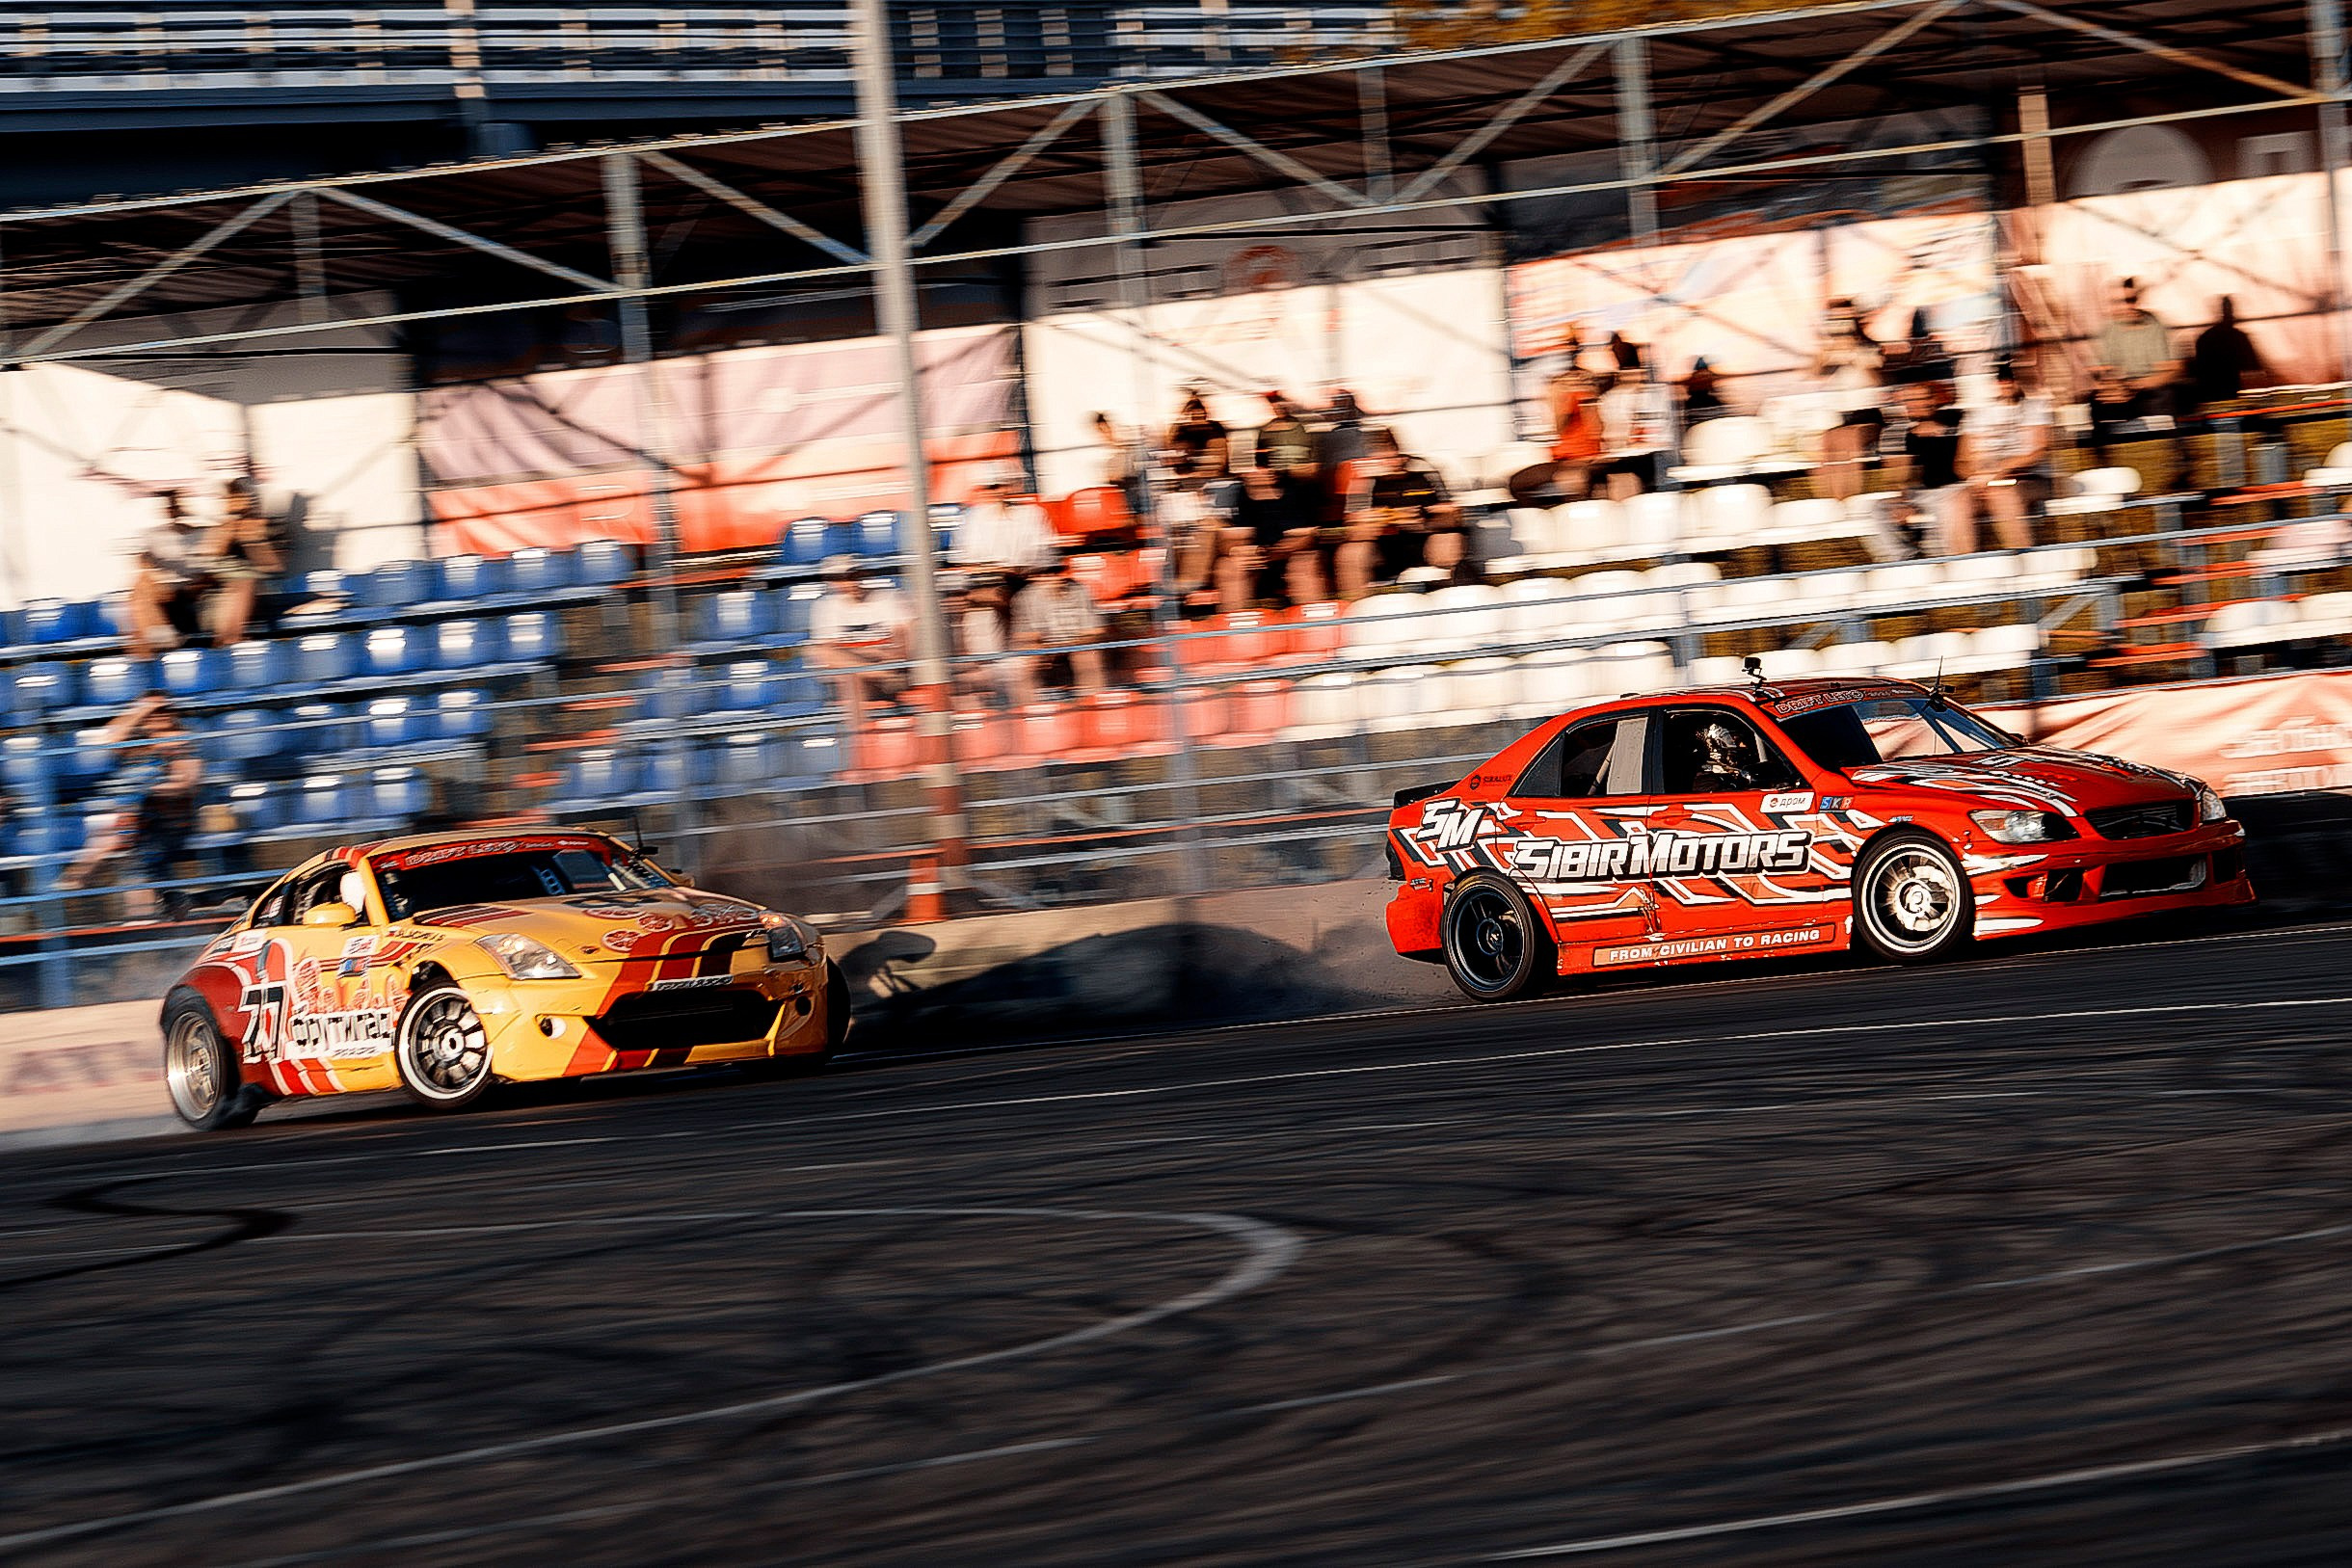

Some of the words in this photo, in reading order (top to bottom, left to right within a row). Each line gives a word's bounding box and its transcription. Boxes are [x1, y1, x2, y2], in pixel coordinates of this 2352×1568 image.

[1416, 799, 1486, 850] SM
[1610, 947, 1653, 962] FROM
[1659, 939, 1727, 955] CIVILIAN
[1733, 936, 1754, 948] TO
[1760, 929, 1820, 945] RACING
